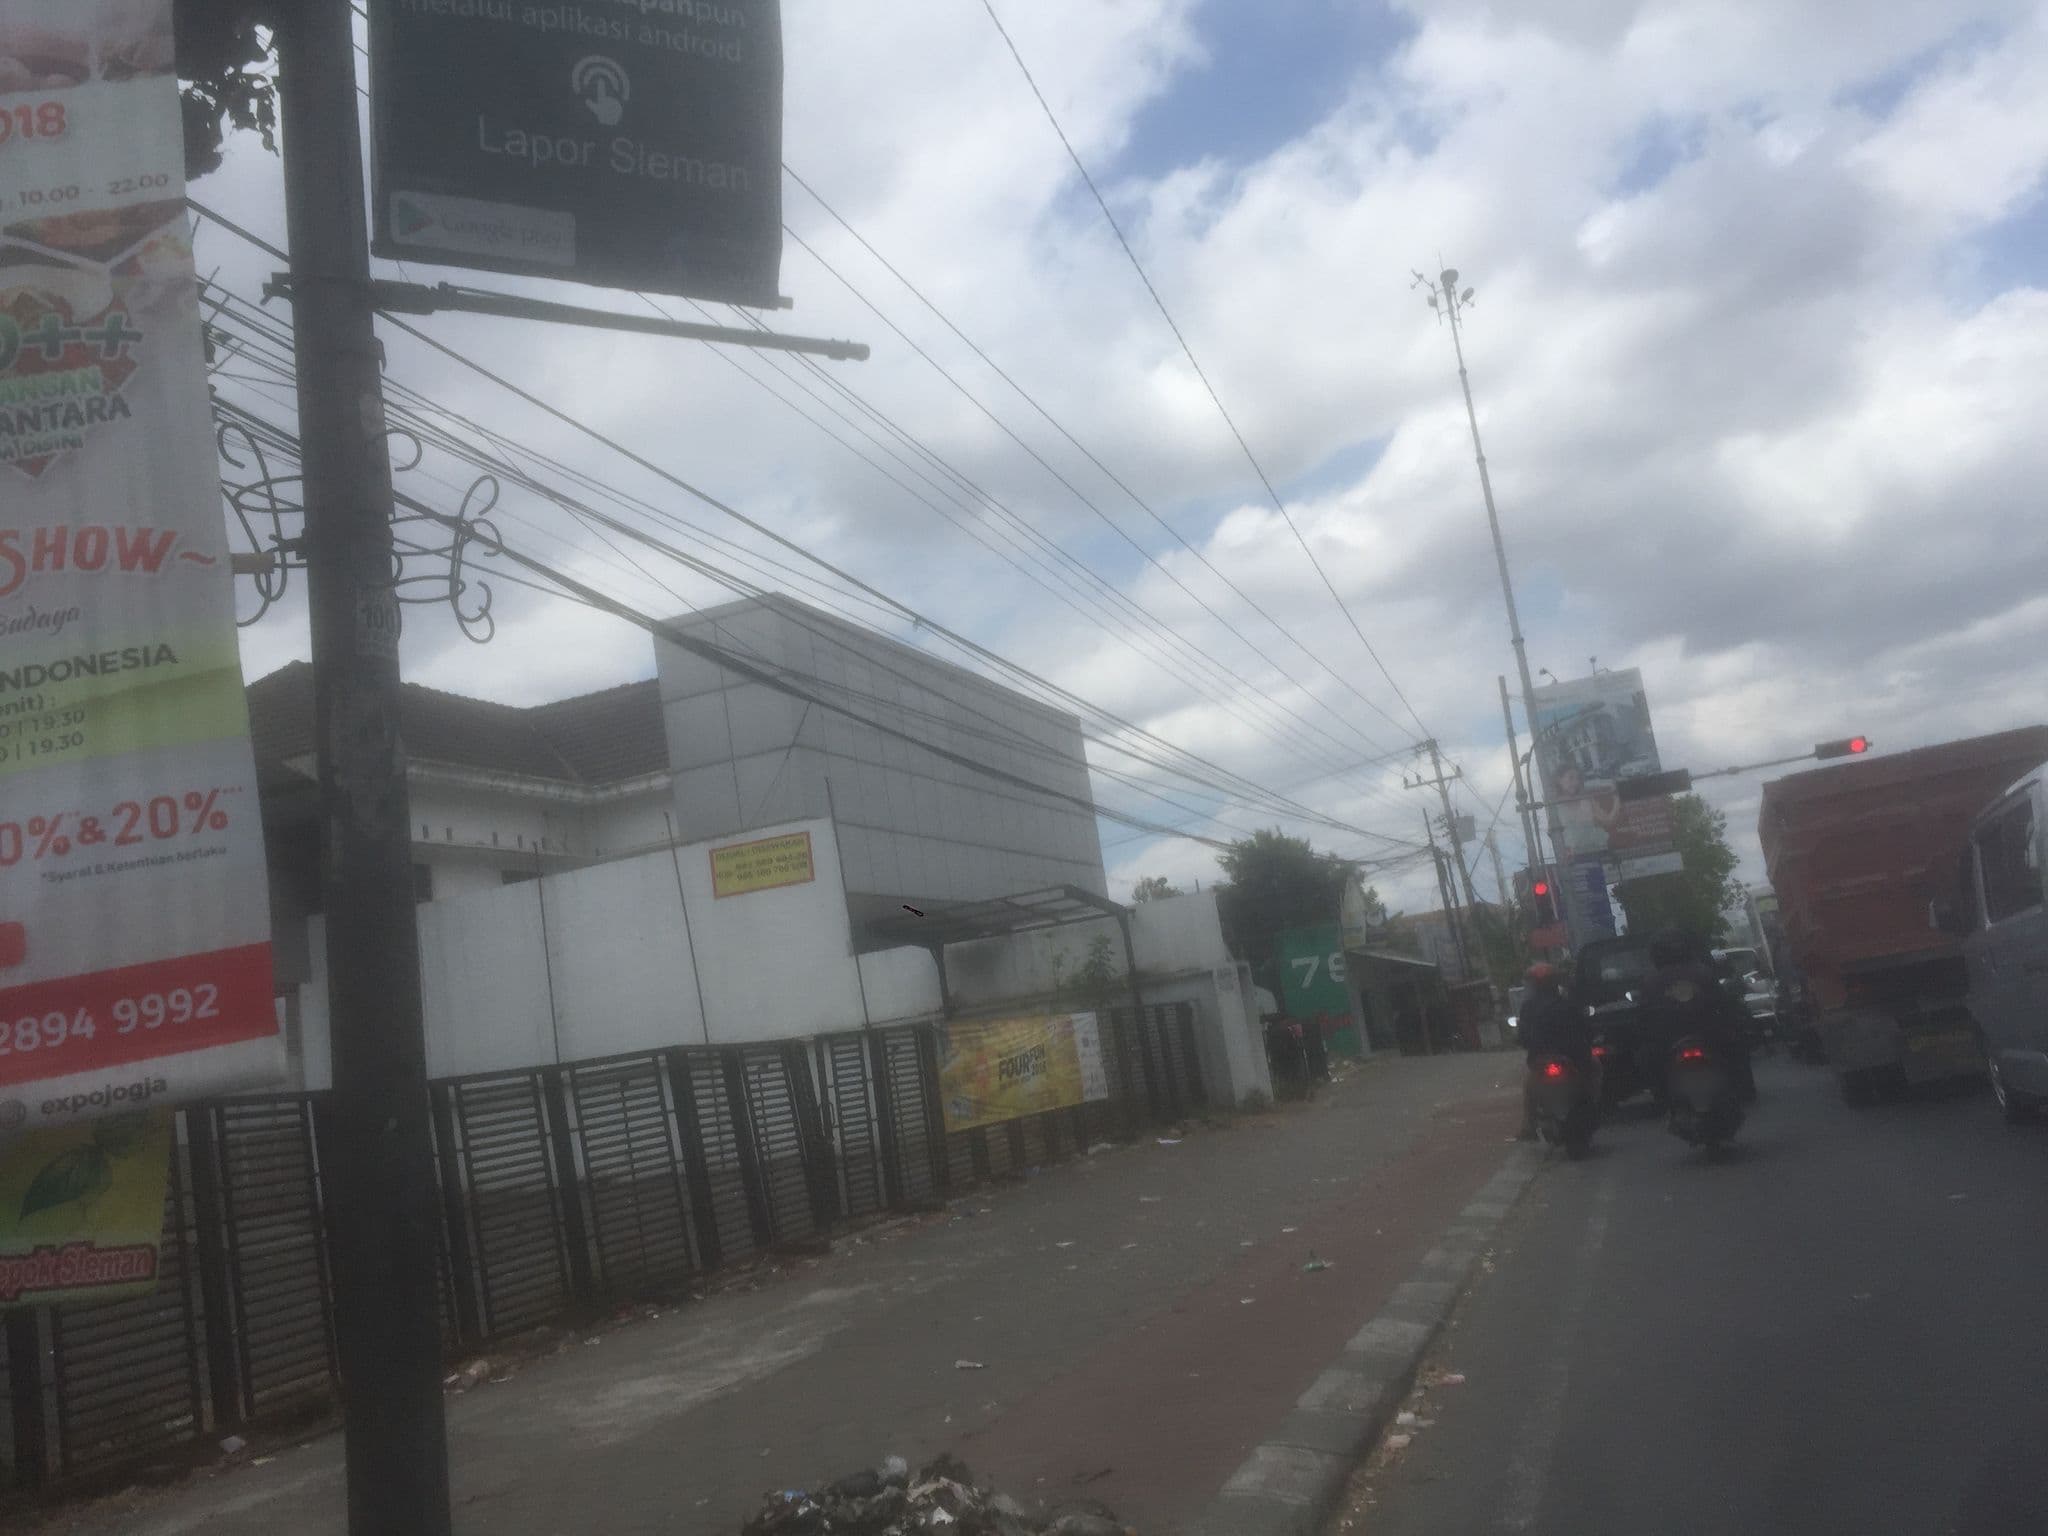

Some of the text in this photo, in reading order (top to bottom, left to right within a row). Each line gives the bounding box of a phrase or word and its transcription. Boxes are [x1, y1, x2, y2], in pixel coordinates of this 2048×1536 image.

[521, 6, 630, 41] aplikasi
[638, 26, 743, 63] android
[478, 113, 752, 192] Lapor Sleman
[0, 525, 177, 597] SHOW
[113, 983, 220, 1034] 9992
[41, 1076, 168, 1115] expojogja
